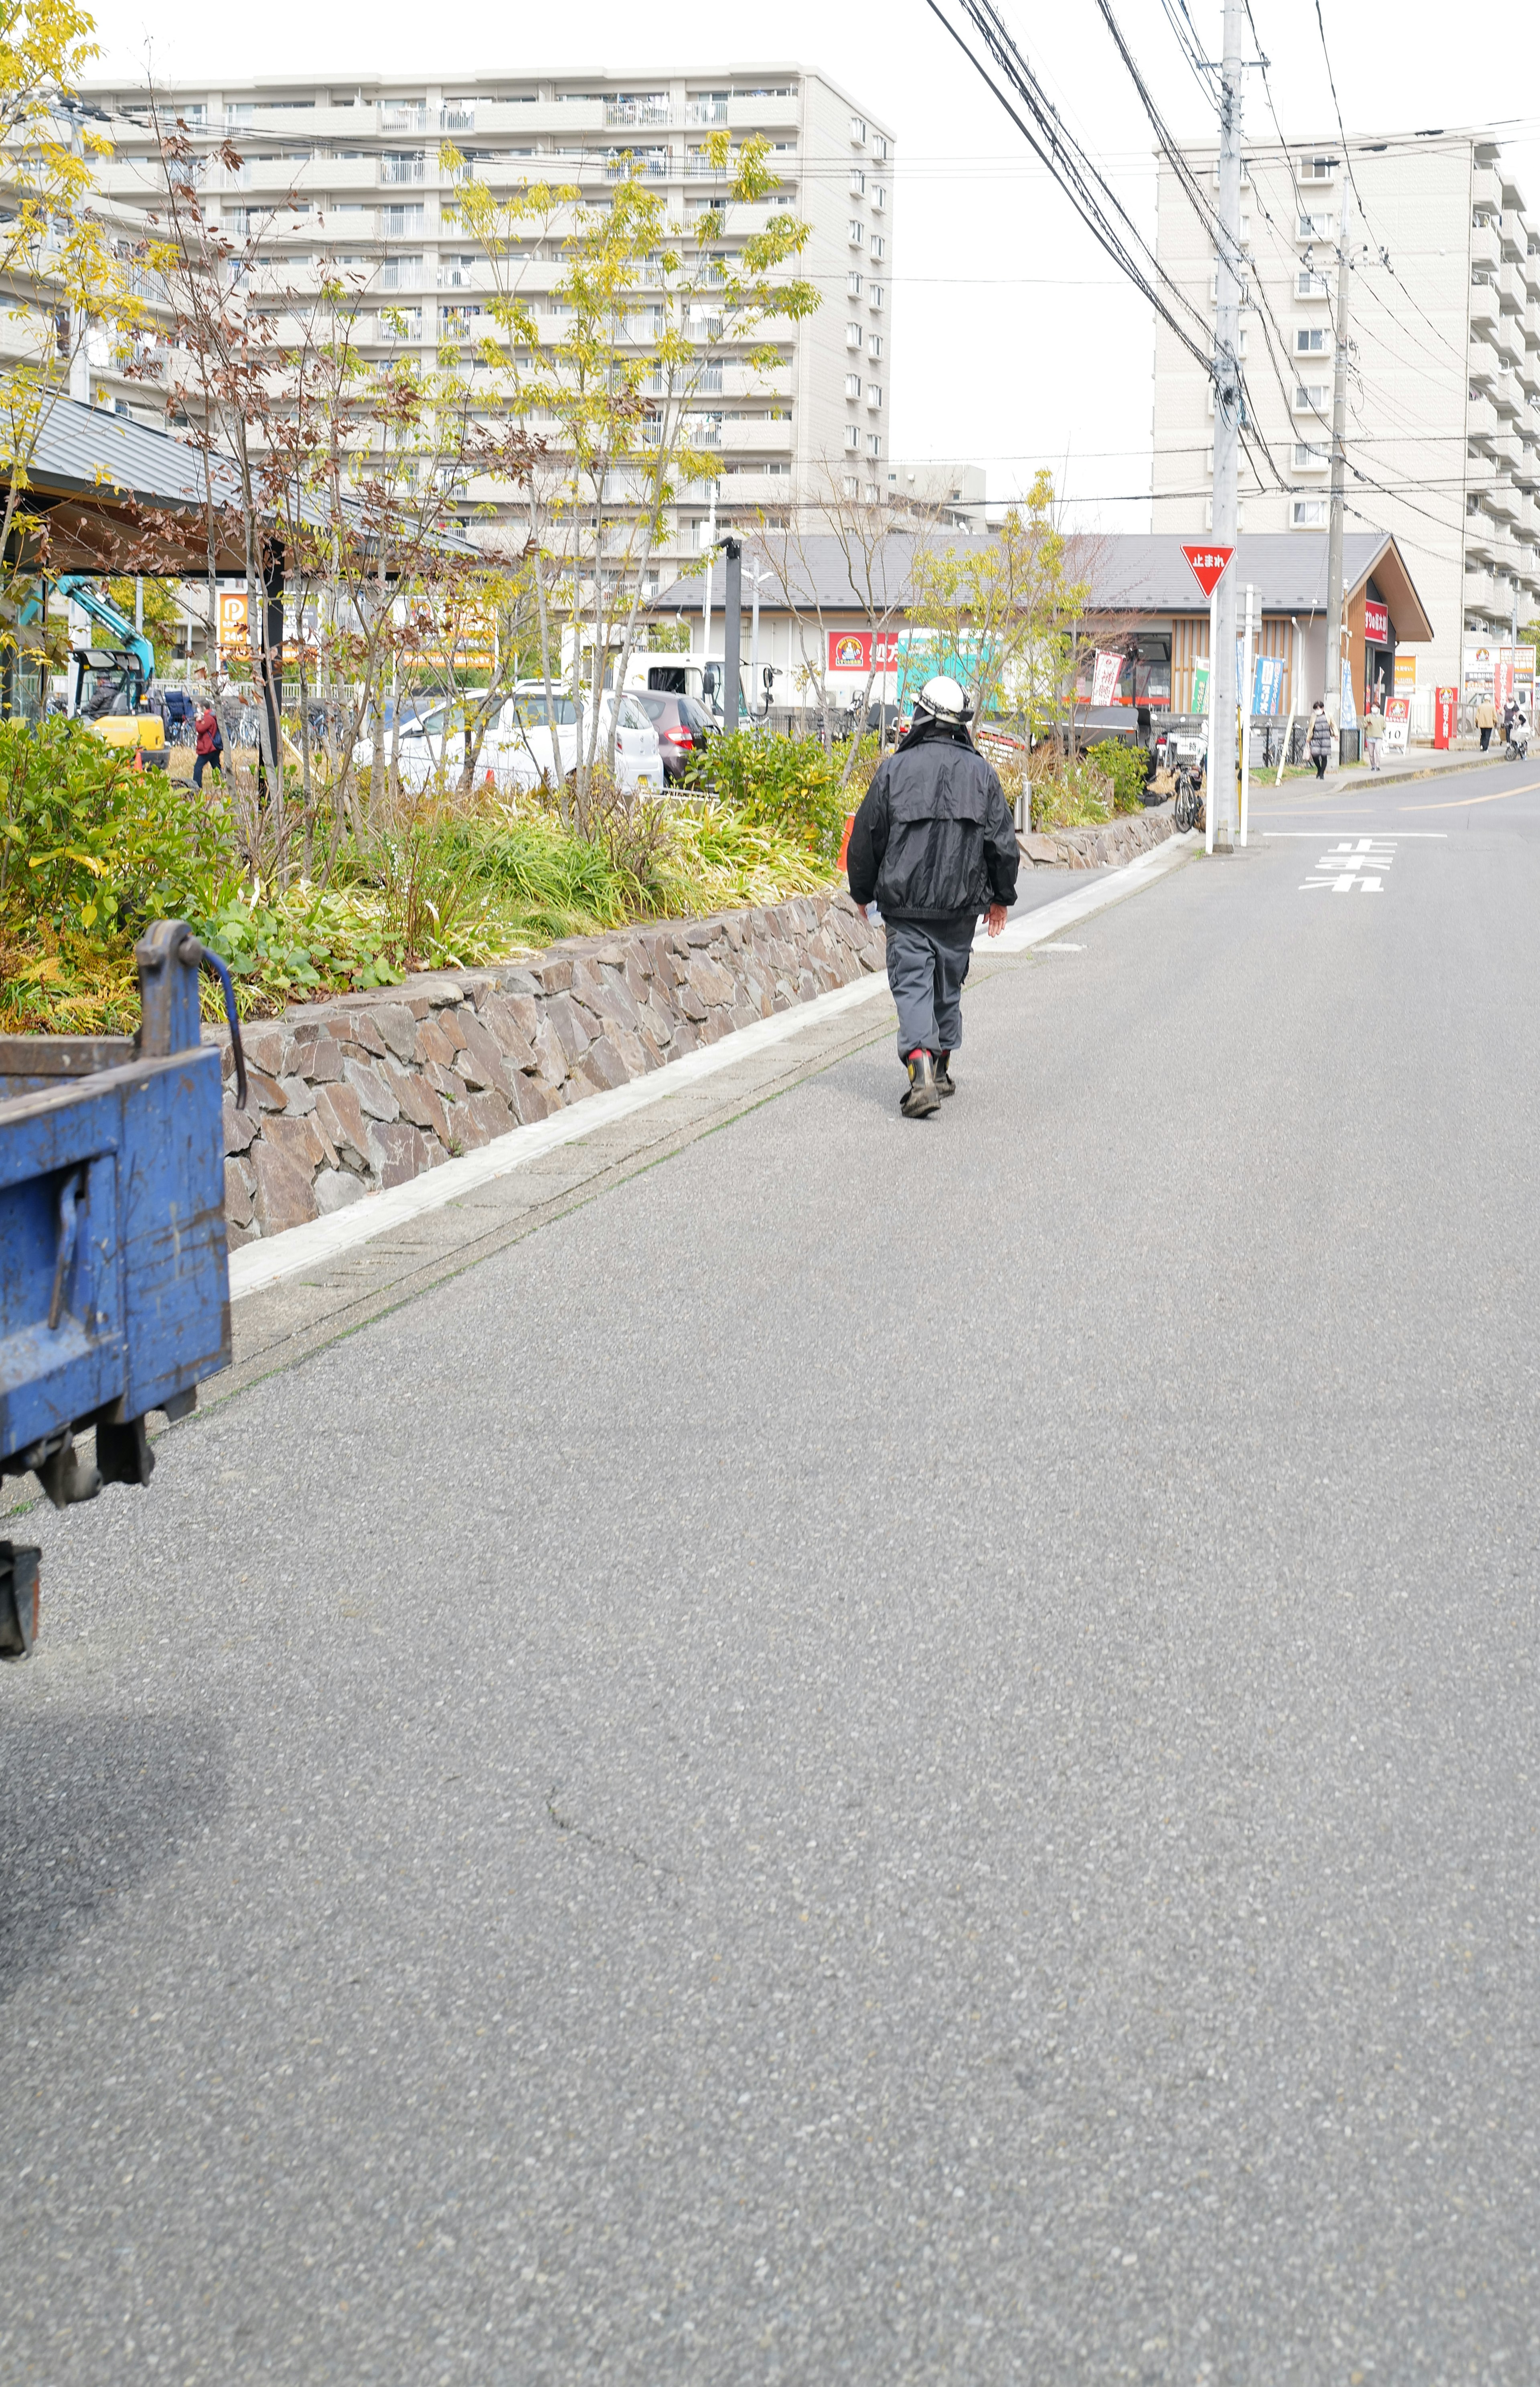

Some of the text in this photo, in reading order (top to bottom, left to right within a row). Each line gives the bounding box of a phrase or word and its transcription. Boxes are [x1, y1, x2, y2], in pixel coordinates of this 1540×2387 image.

[1193, 554, 1224, 568] 止まれ
[1298, 839, 1397, 892] 止まれ
